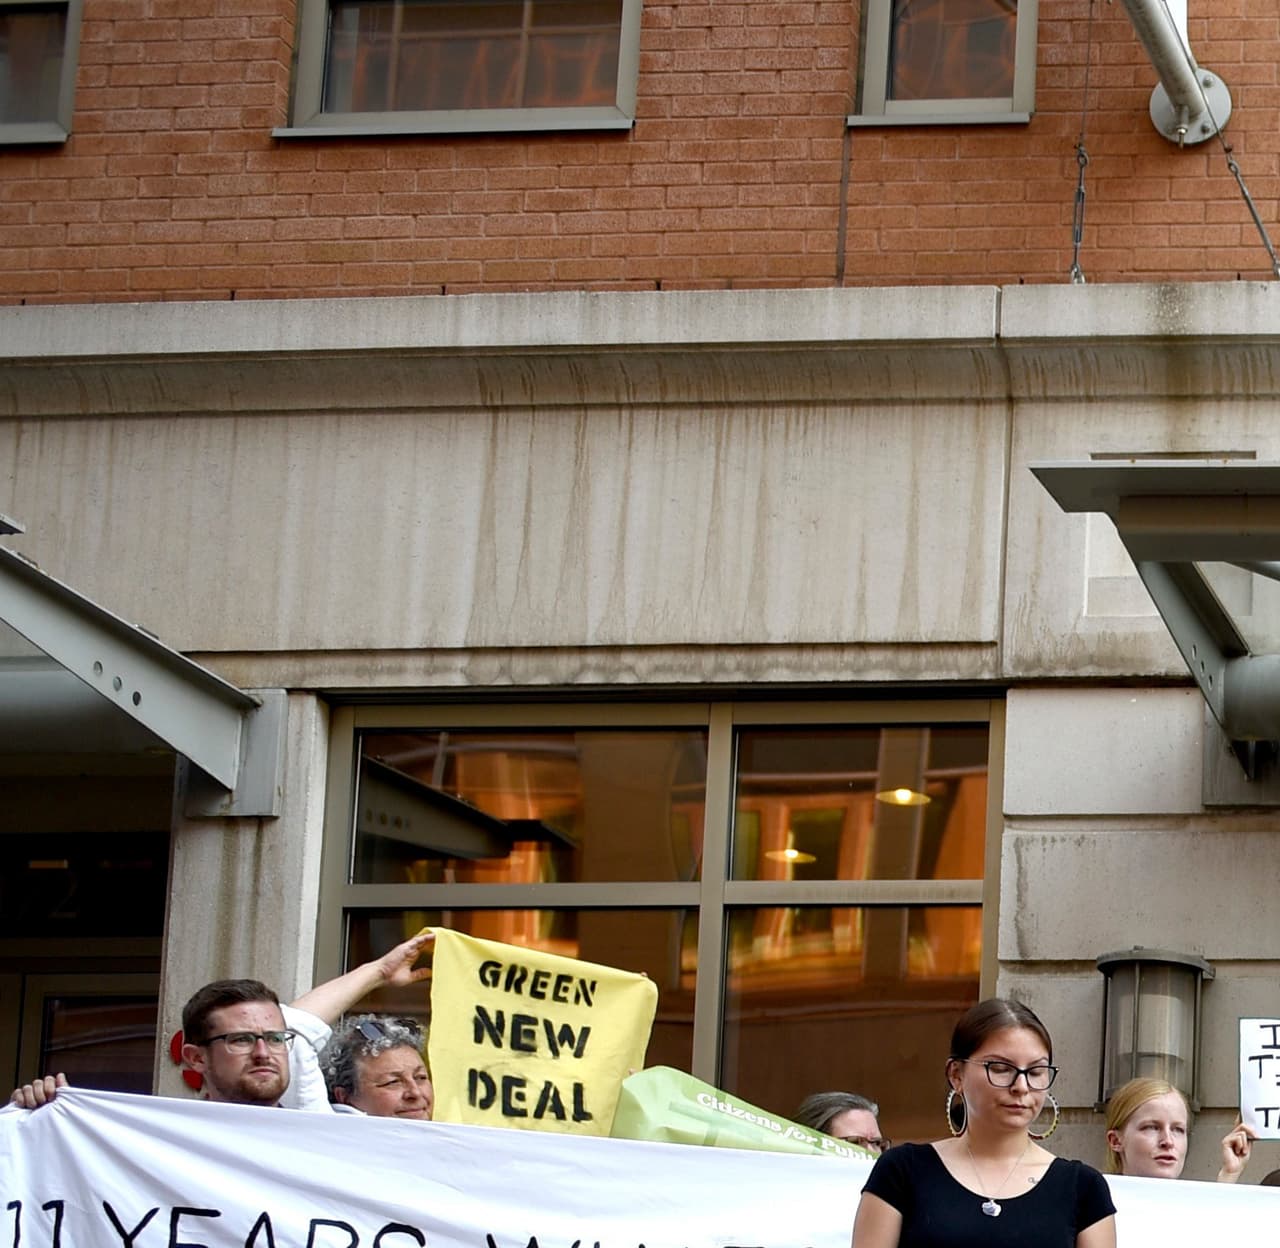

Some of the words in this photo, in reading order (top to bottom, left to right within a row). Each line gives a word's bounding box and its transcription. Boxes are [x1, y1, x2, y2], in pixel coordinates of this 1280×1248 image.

[478, 960, 597, 1007] GREEN
[473, 1005, 591, 1059] NEW
[468, 1068, 593, 1123] DEAL
[697, 1092, 783, 1132] Citizens
[781, 1126, 818, 1144] for
[821, 1136, 873, 1161] Publ
